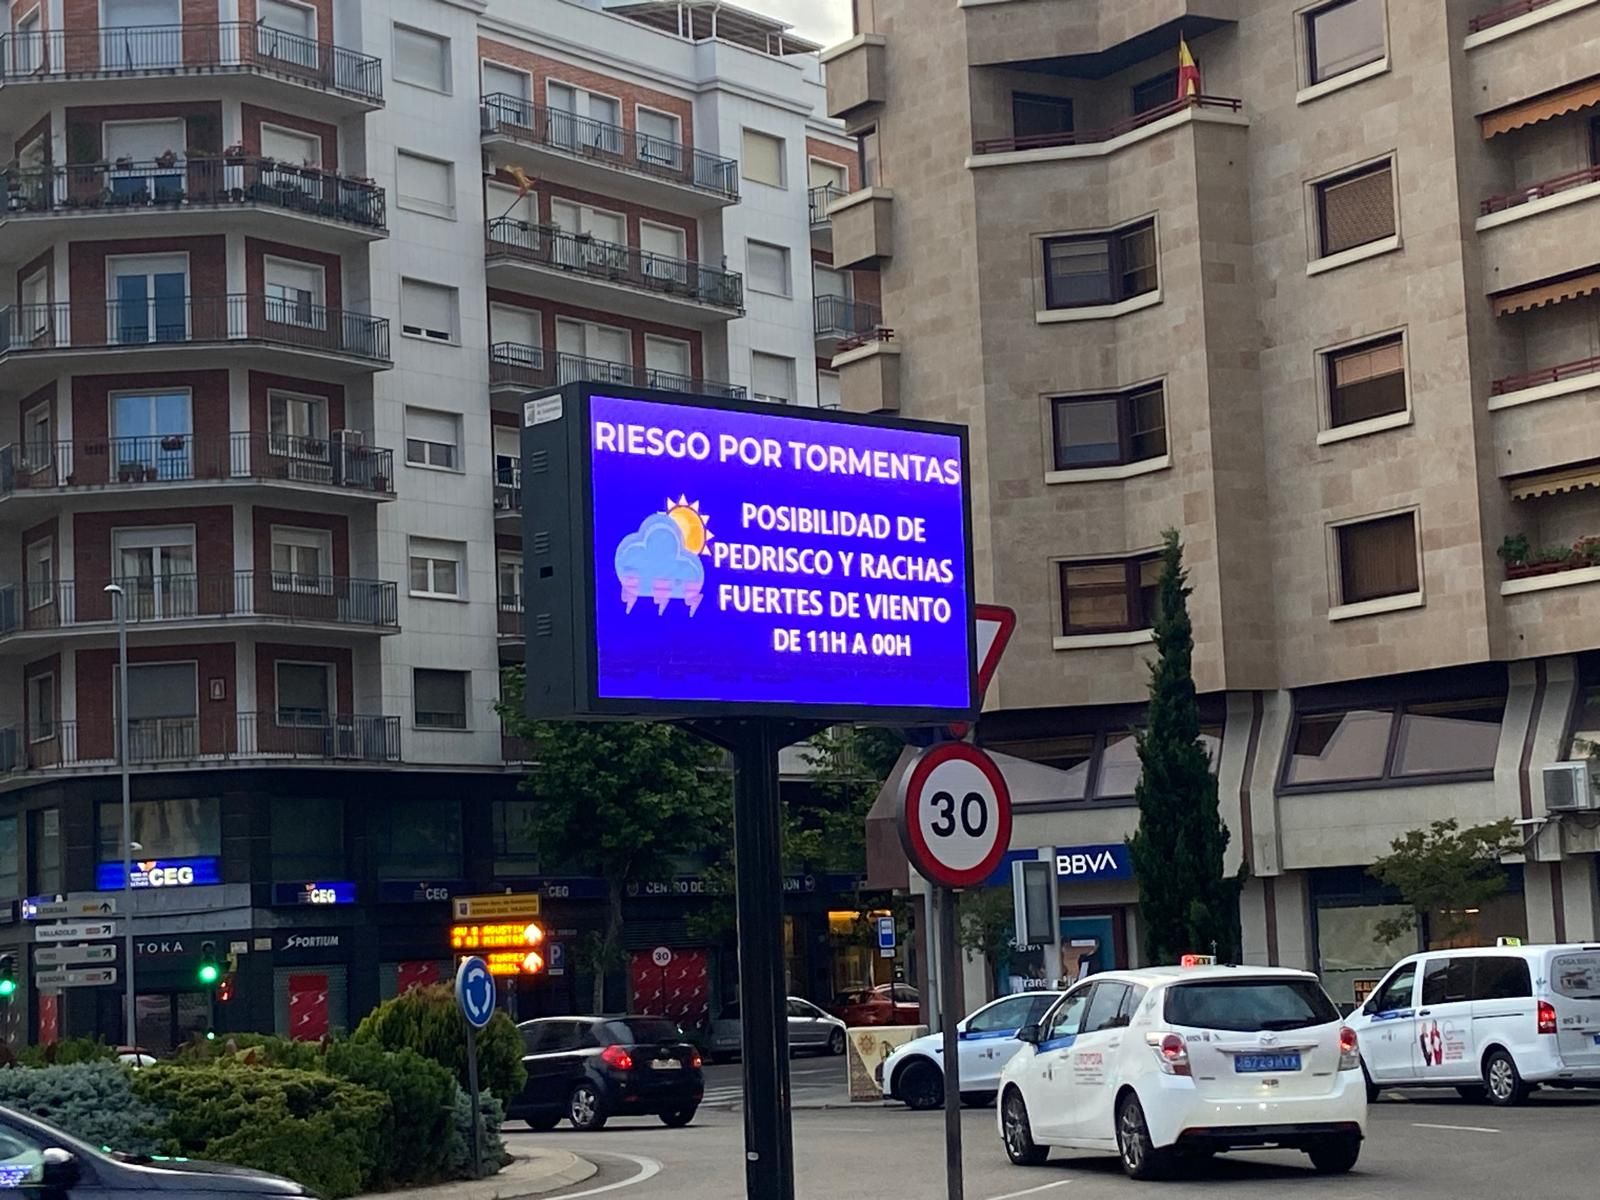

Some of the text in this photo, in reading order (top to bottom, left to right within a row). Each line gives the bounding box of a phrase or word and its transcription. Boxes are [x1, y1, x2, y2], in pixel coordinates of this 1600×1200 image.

[595, 421, 960, 485] RIESGO POR TORMENTAS
[742, 502, 926, 543] POSIBILIDAD DE
[713, 541, 954, 584] PEDRISCO Y RACHAS
[719, 584, 951, 623] FUERTES DE VIENTO
[773, 628, 911, 657] DE 11H A 00H
[930, 790, 988, 838] 30
[1057, 850, 1117, 875] BBVA
[149, 866, 194, 887] CEG
[425, 887, 448, 900] CEG
[548, 885, 569, 897] CEG
[645, 881, 689, 894] CENRO
[310, 889, 337, 904] CEG
[38, 928, 78, 937] VALLADOLID
[482, 934, 525, 946] MINUTOS
[137, 941, 184, 953] TOKA
[281, 934, 339, 951] SPORTIUM
[654, 951, 669, 961] 30
